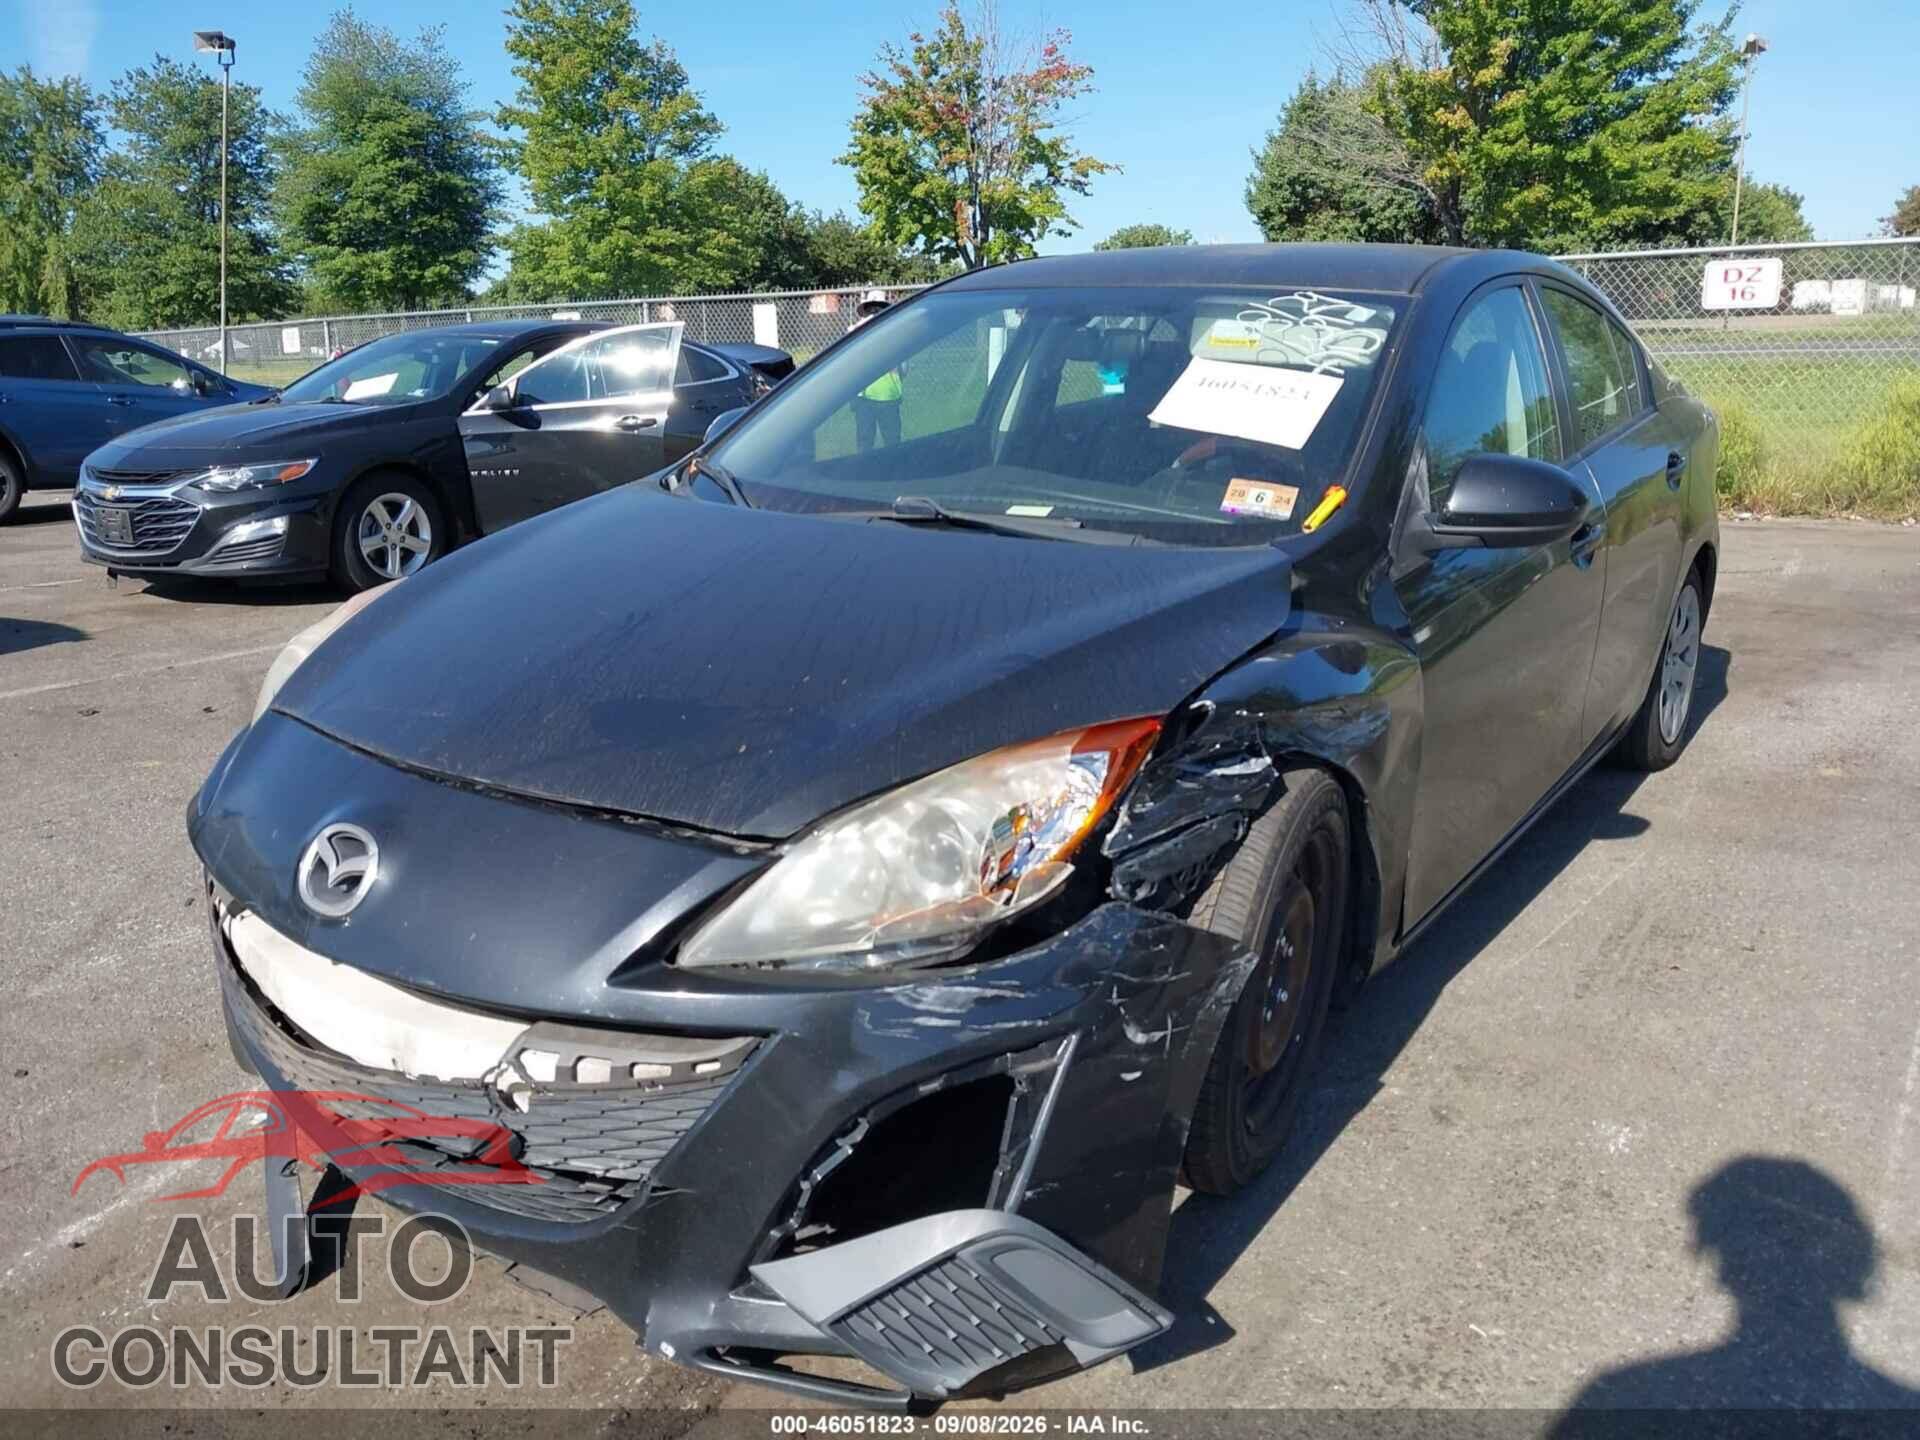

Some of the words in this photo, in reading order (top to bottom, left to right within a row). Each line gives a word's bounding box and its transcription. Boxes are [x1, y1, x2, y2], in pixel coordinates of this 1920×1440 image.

[1723, 266, 1763, 283] DZ
[1731, 285, 1756, 301] 16
[1254, 491, 1266, 504] 6
